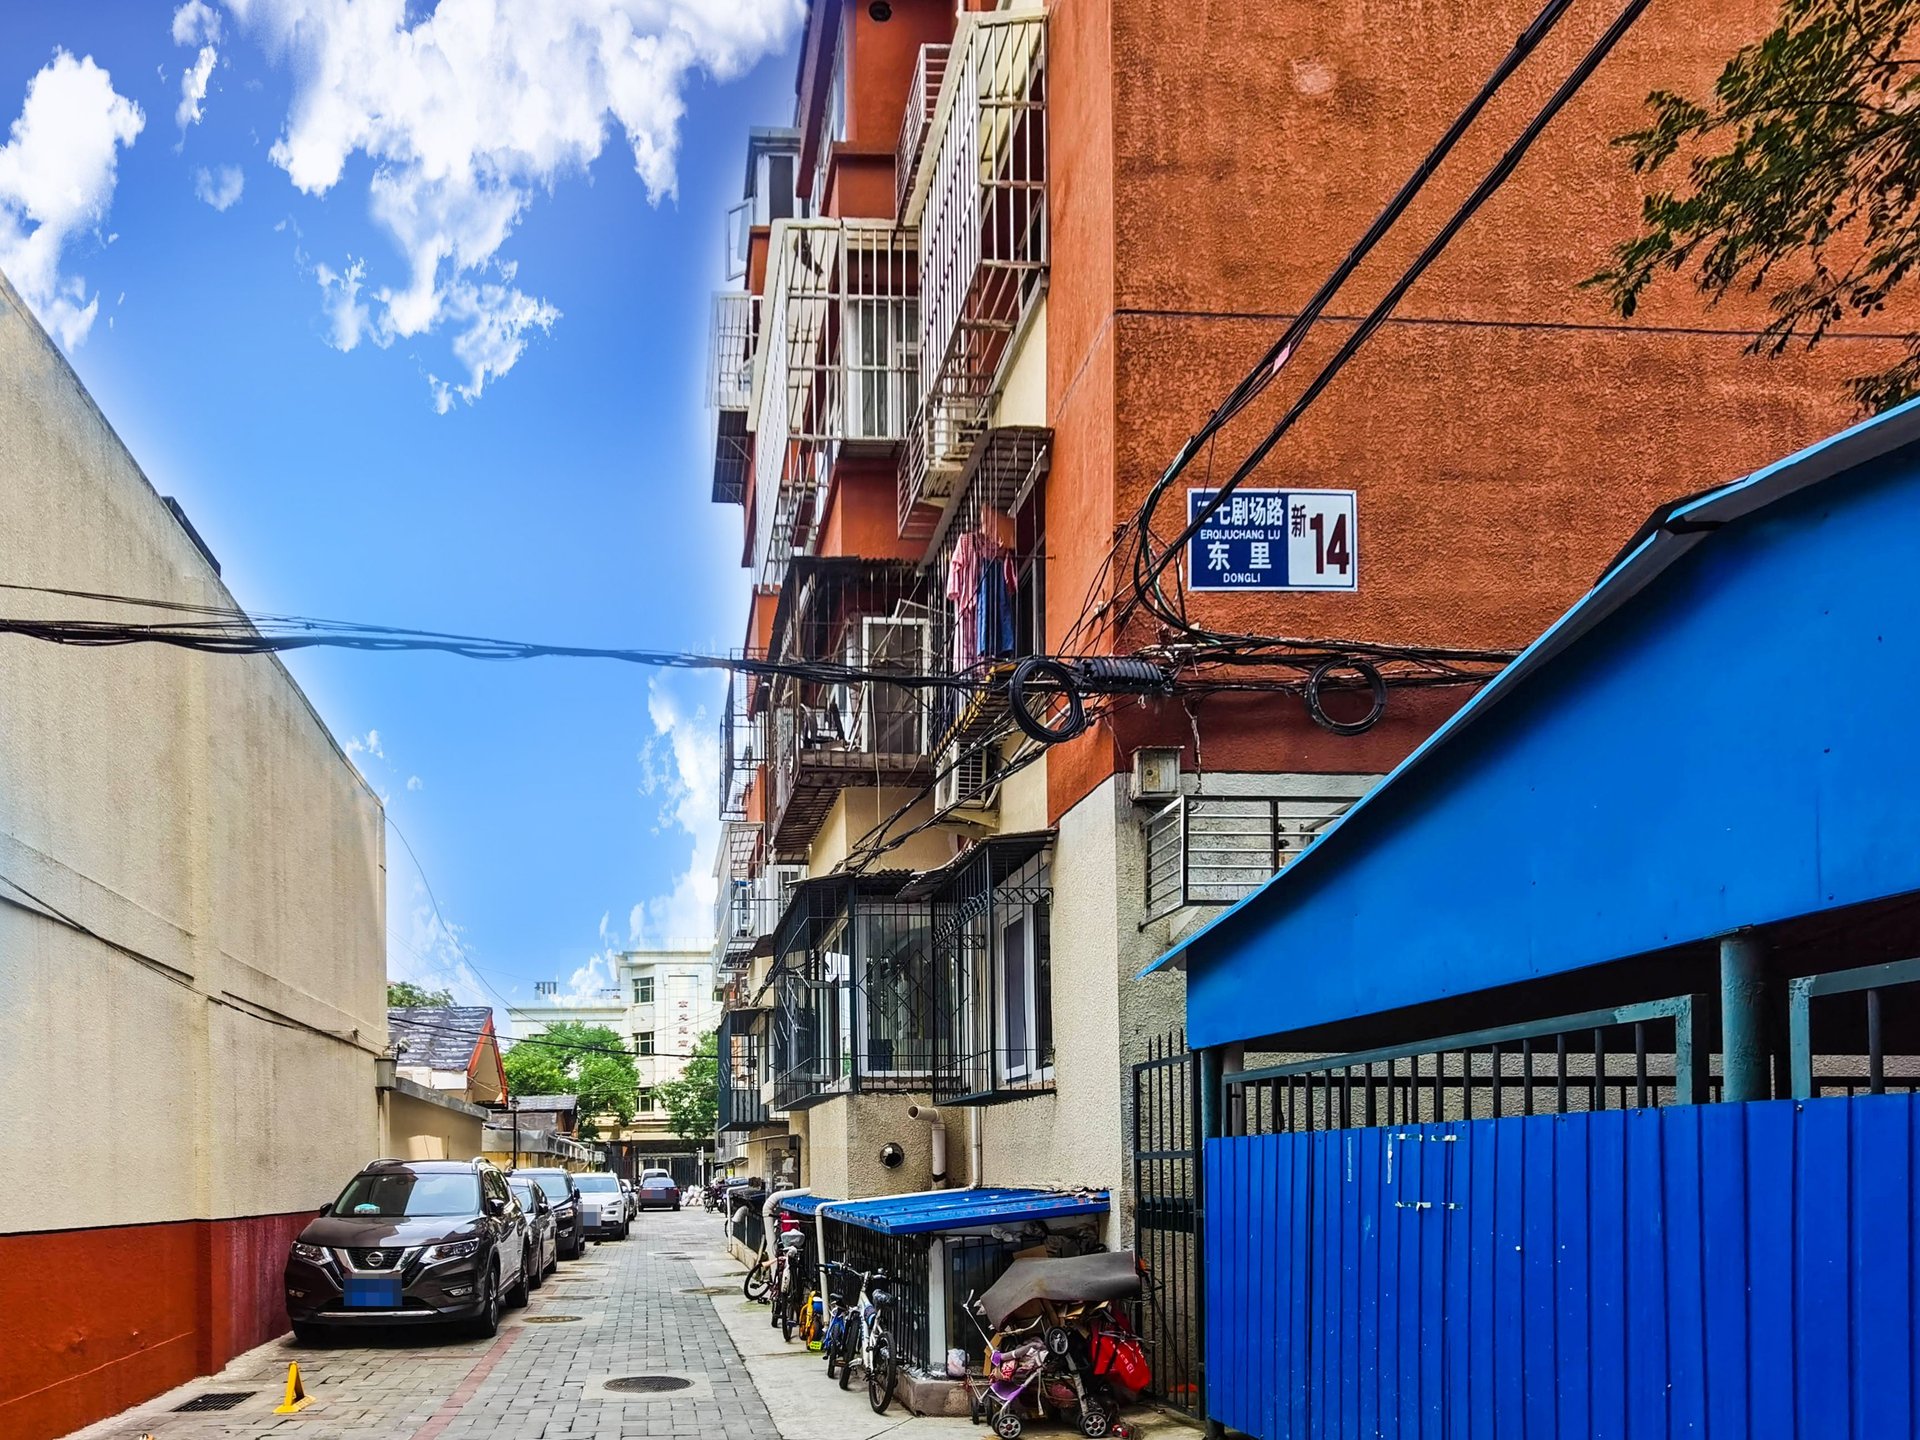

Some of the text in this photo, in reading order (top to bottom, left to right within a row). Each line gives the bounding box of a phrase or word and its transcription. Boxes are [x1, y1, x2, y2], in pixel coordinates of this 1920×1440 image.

[1200, 529, 1280, 540] ERQIJUCHANG LU
[1291, 503, 1350, 574] 新 14
[1223, 572, 1261, 583] DONGLI
